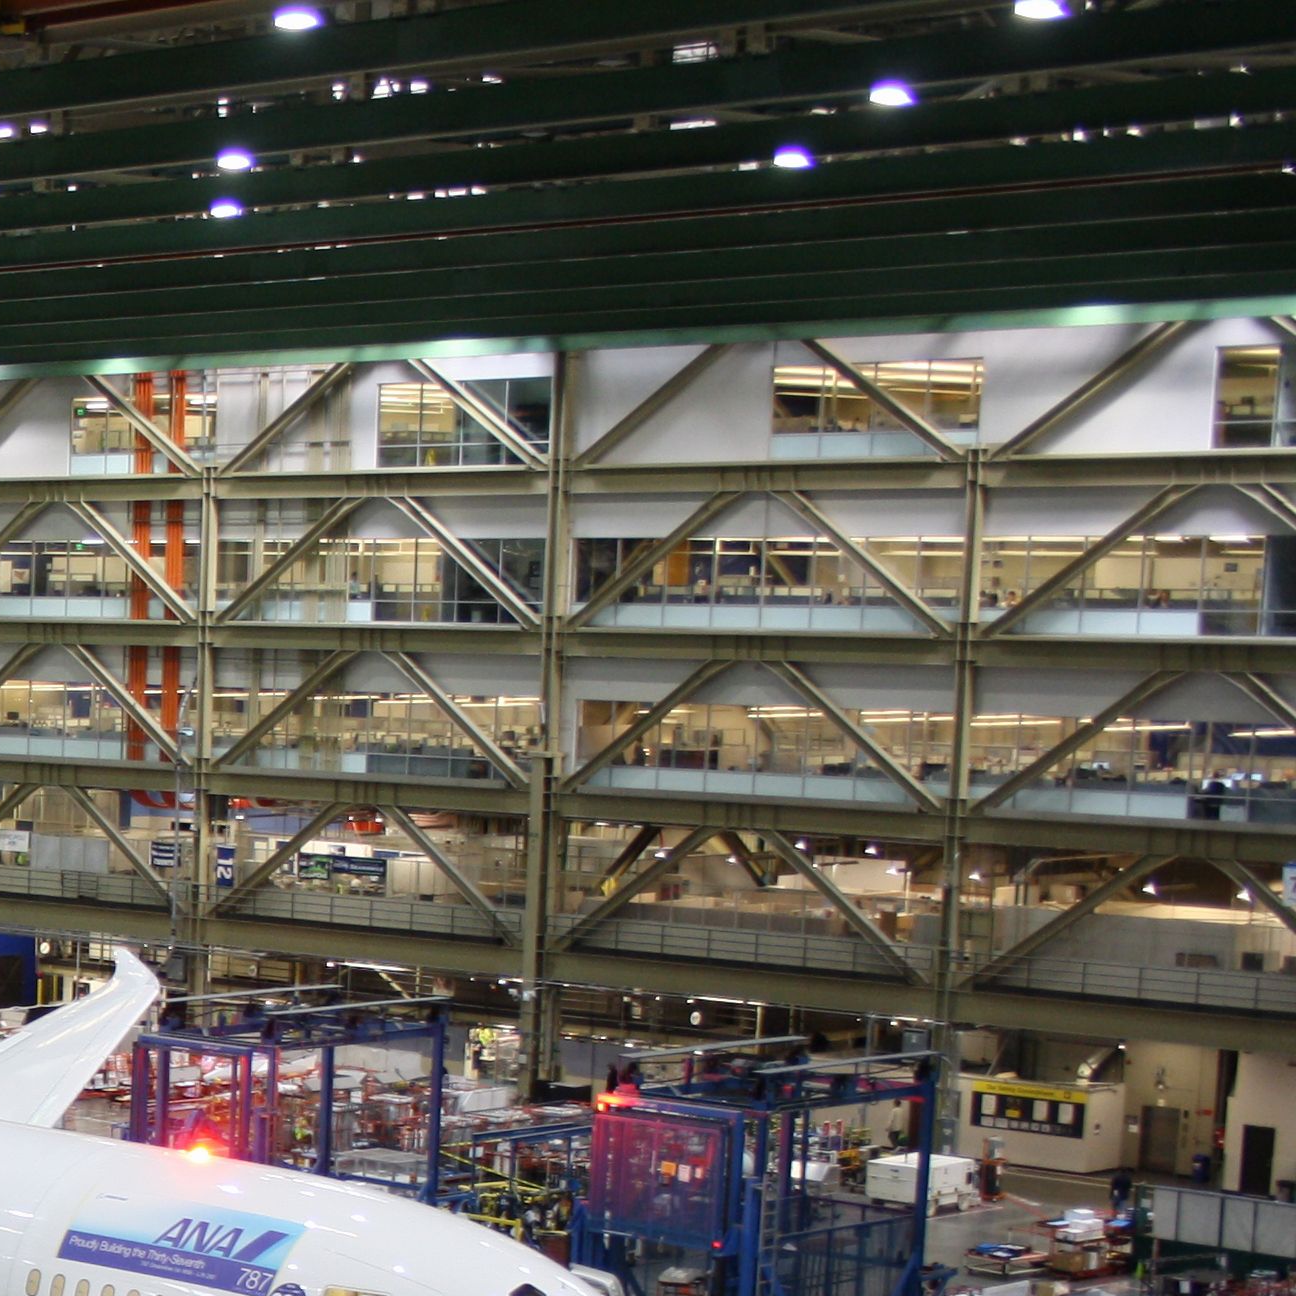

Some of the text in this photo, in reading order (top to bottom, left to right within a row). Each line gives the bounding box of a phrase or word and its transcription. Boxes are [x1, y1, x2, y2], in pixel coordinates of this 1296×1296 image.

[216, 857, 233, 880] 12
[69, 1235, 206, 1269] Proudly Building the Thirty-Seventh
[153, 1218, 244, 1258] ANA
[236, 1267, 274, 1291] 787
